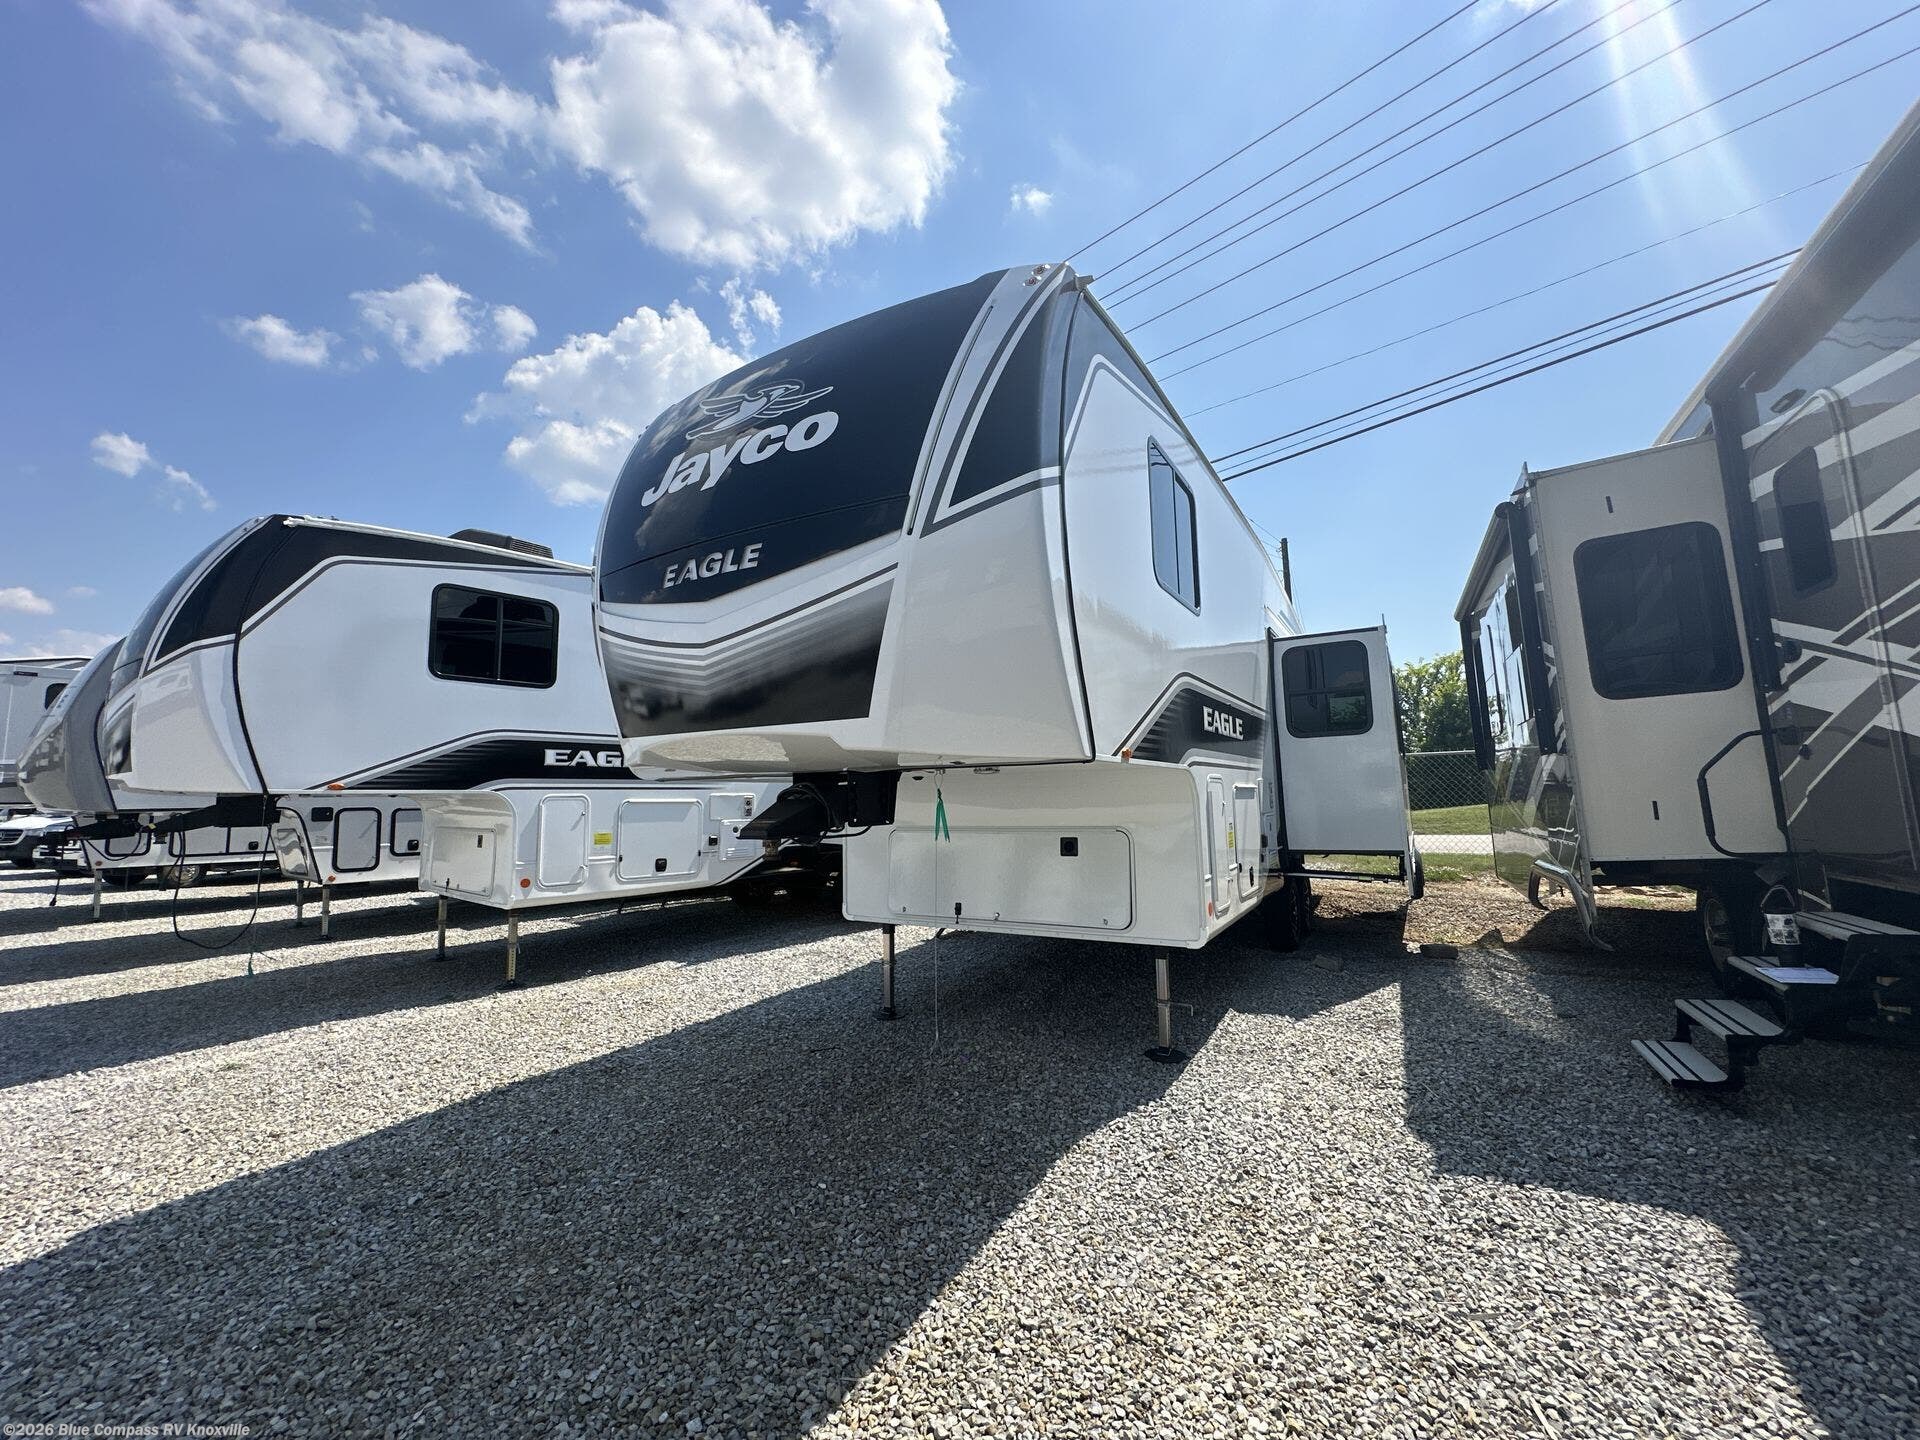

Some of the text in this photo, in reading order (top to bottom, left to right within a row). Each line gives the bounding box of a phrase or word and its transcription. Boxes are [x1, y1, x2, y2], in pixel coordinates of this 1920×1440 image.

[641, 411, 839, 507] Jayco
[663, 543, 763, 589] EAGLE
[1203, 705, 1244, 740] EAGLE
[544, 749, 622, 767] EAG
